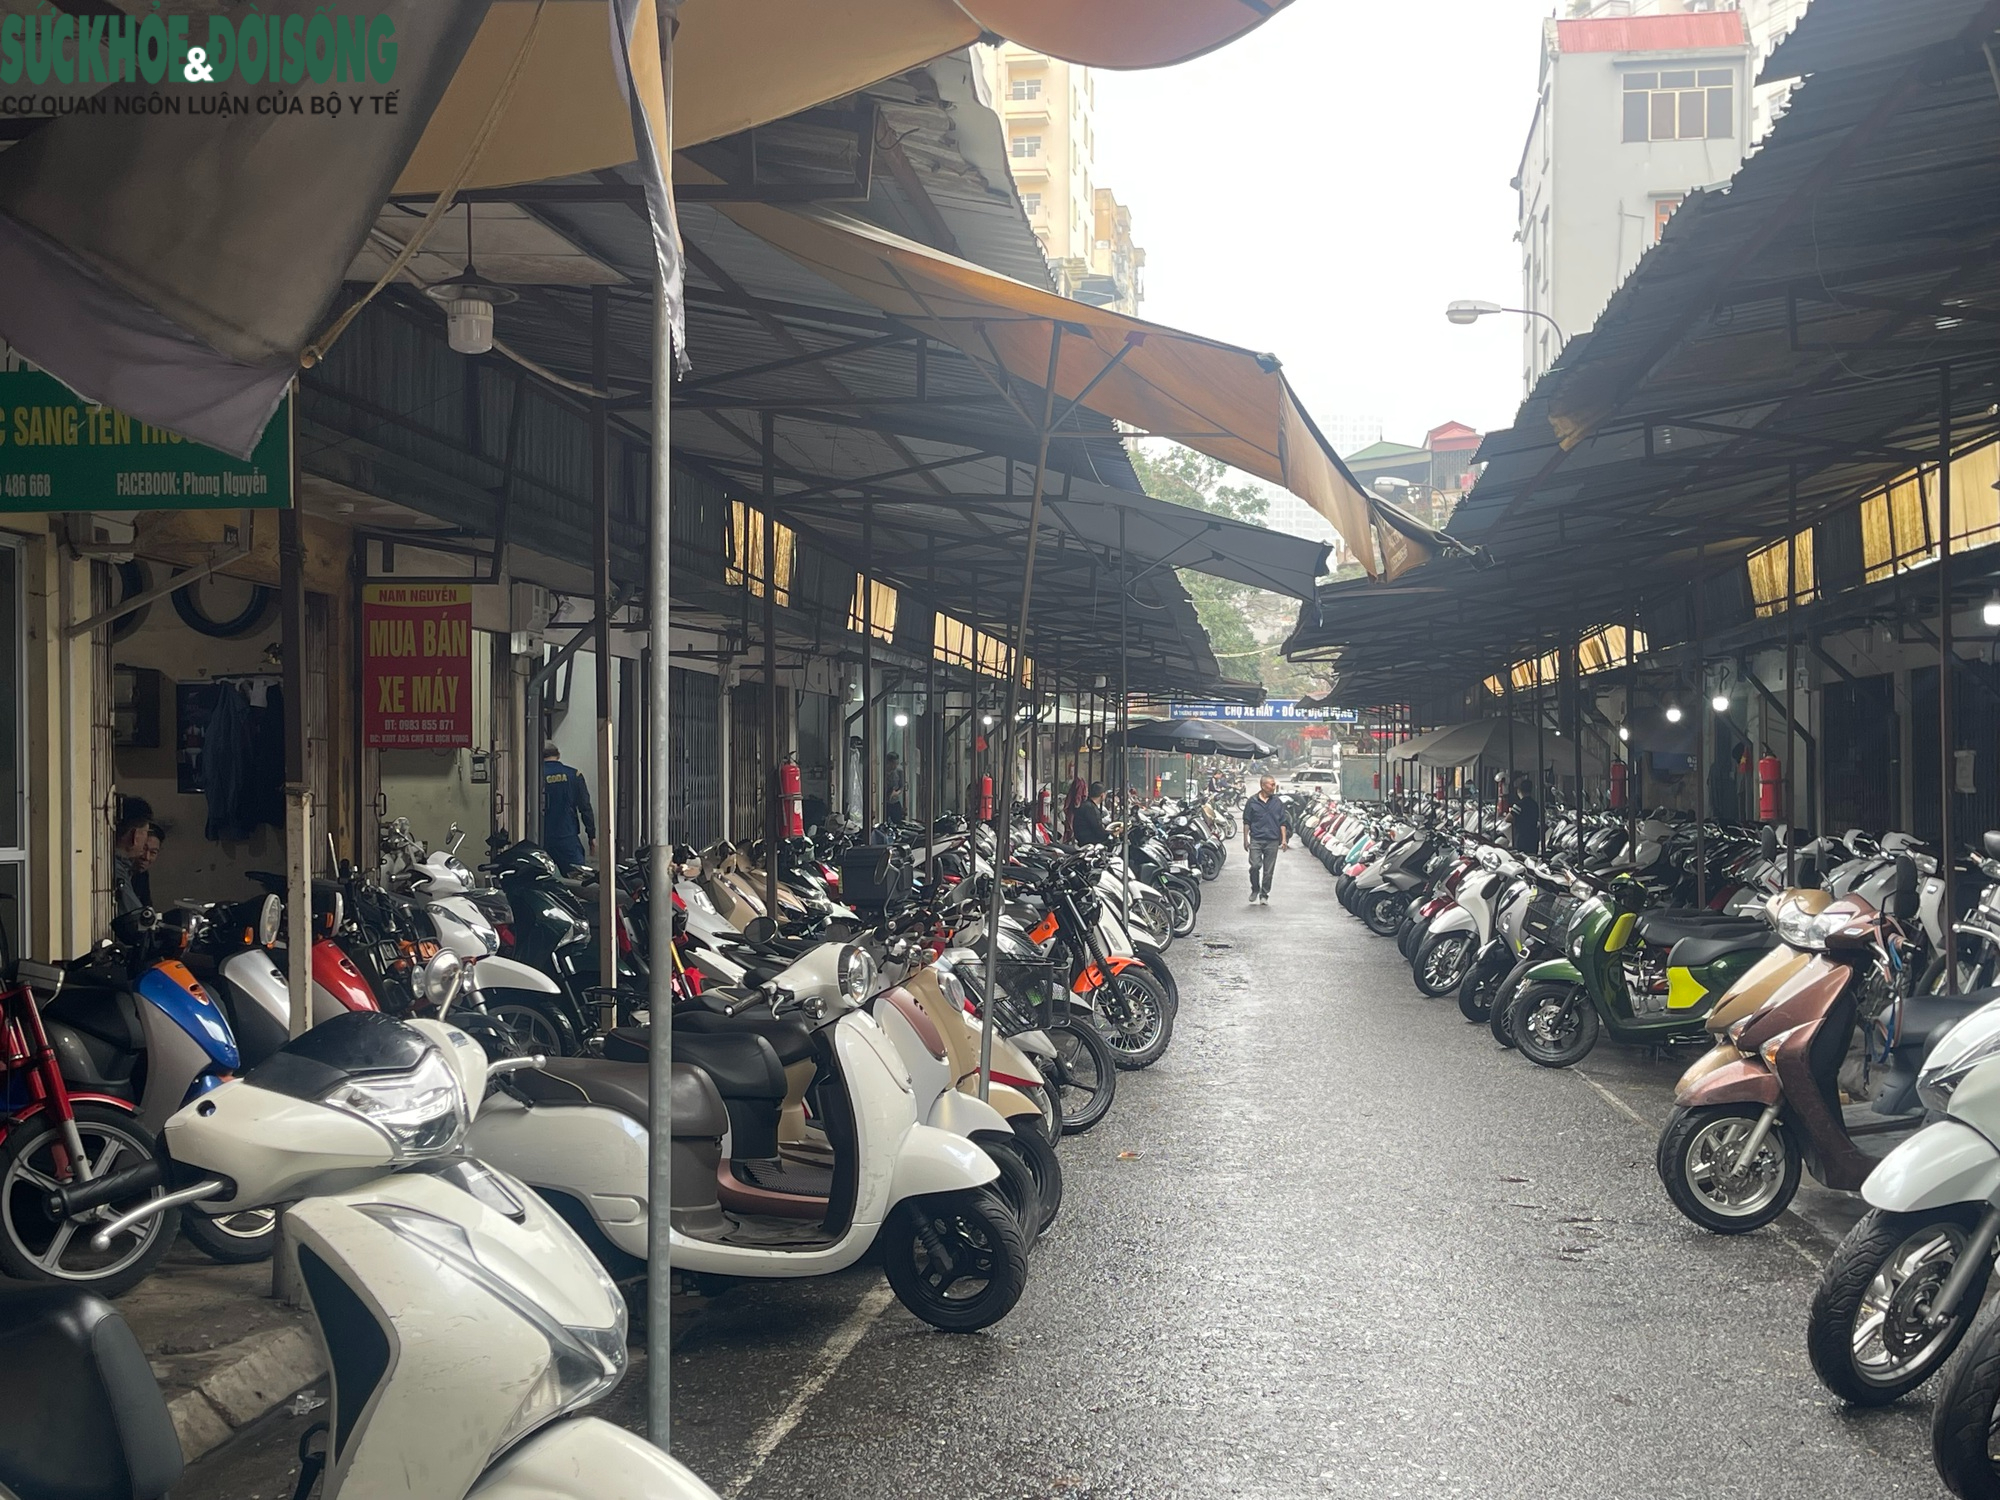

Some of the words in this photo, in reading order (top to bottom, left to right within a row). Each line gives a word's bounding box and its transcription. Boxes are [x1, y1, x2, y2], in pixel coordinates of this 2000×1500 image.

[14, 406, 78, 446] SANG
[5, 474, 26, 497] 486
[29, 474, 51, 497] 668
[116, 472, 180, 496] FACEBOOK:
[183, 472, 220, 497] Phong
[223, 467, 267, 497] Nguyễn
[379, 590, 406, 602] NAM
[369, 620, 417, 657] MUA
[423, 612, 467, 657] BÁN
[378, 676, 406, 713] XE
[412, 668, 459, 713] MÁY
[1244, 706, 1255, 717] XE
[1256, 703, 1274, 717] MÁY
[422, 719, 437, 731] 855
